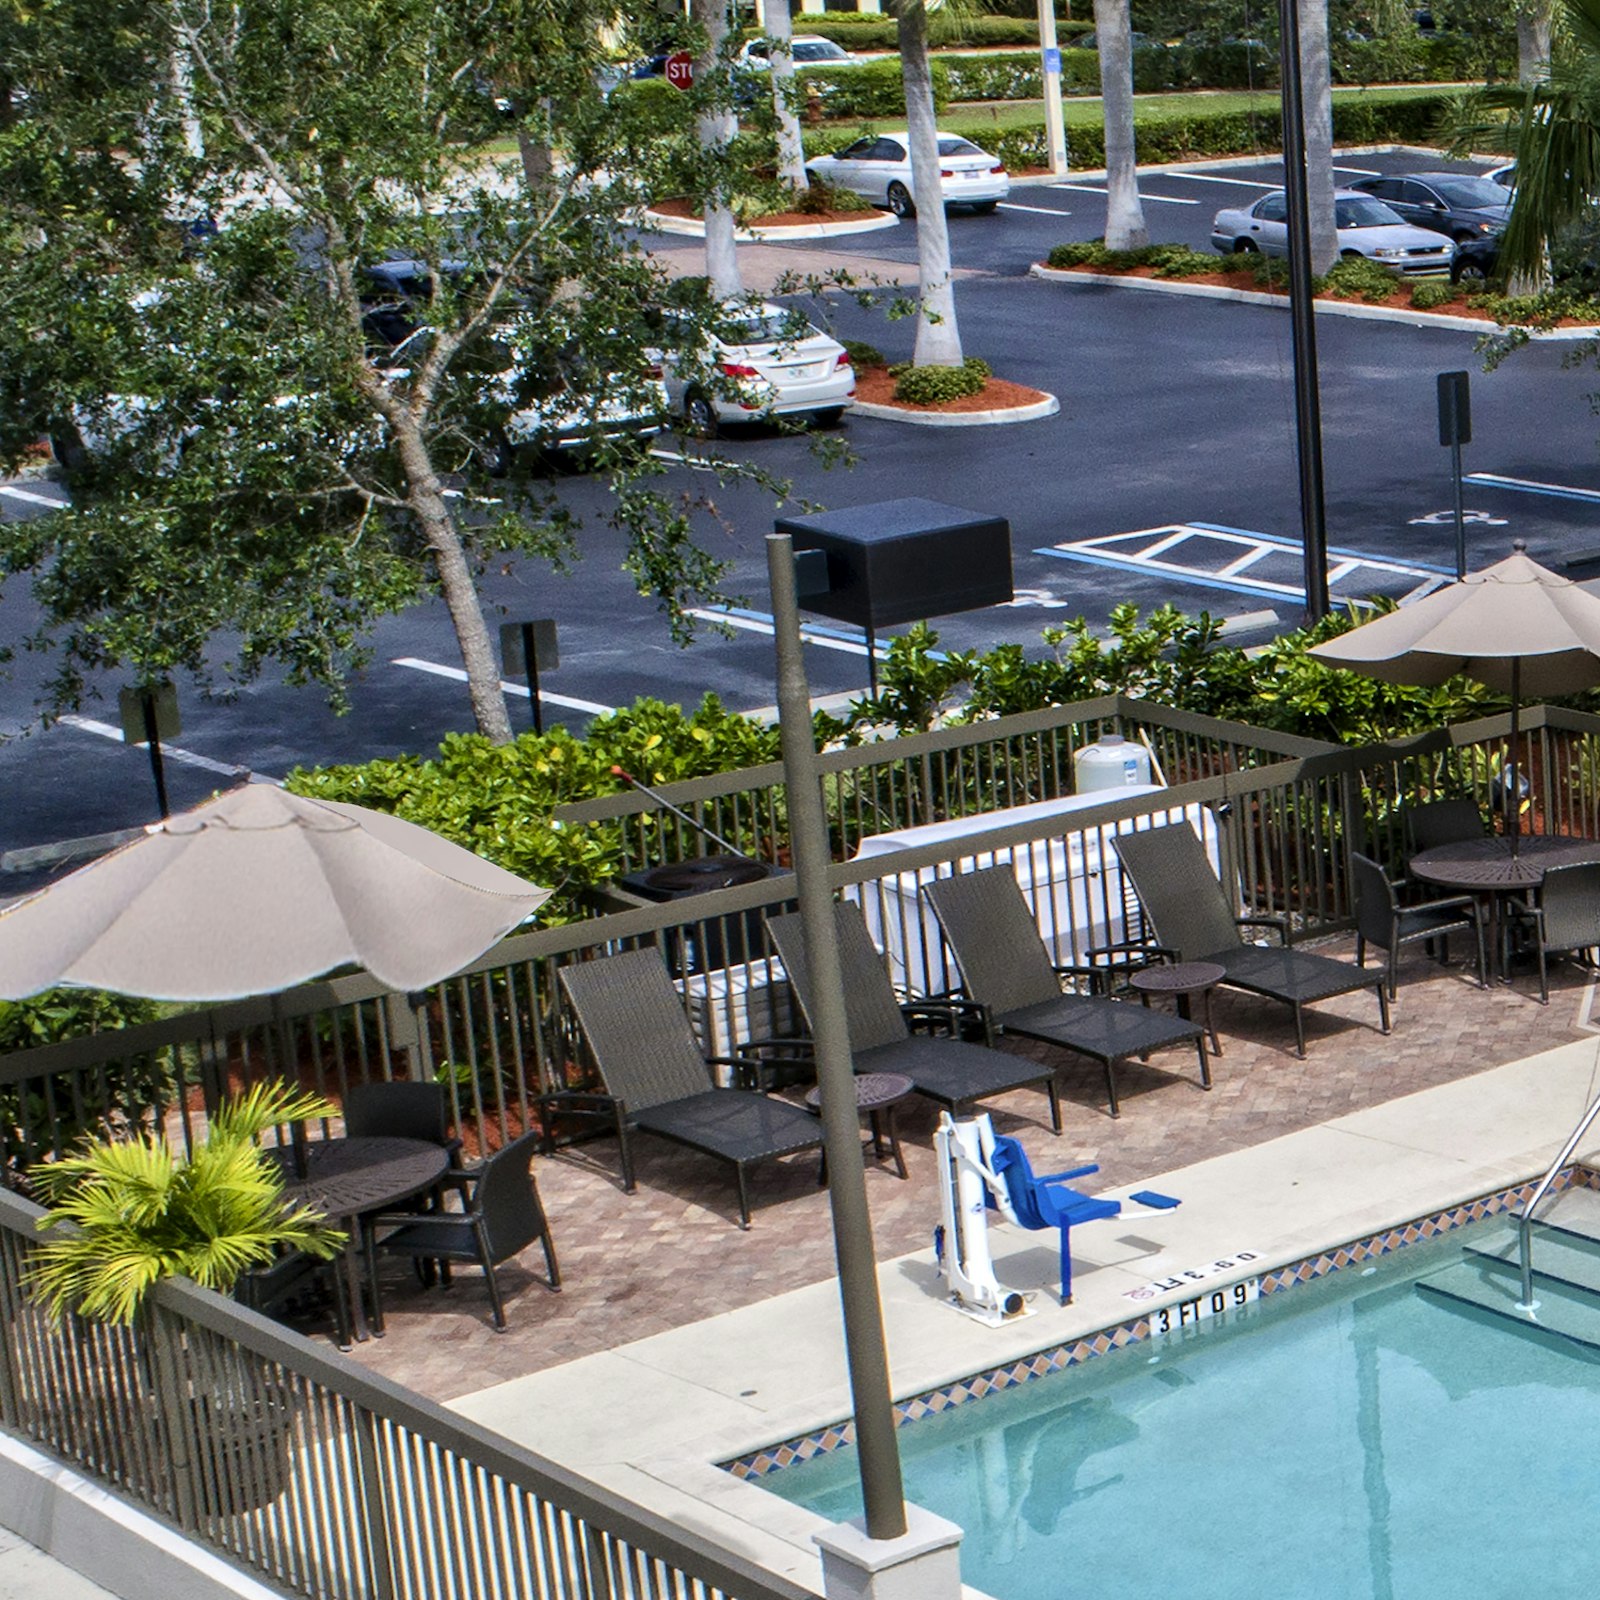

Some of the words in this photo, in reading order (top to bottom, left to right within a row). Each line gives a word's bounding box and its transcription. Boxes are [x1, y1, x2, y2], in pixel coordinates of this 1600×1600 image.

[670, 63, 693, 79] ST
[1184, 1271, 1205, 1280] 3
[1154, 1277, 1184, 1292] FT
[1159, 1310, 1170, 1333] 3
[1180, 1298, 1203, 1326] FT
